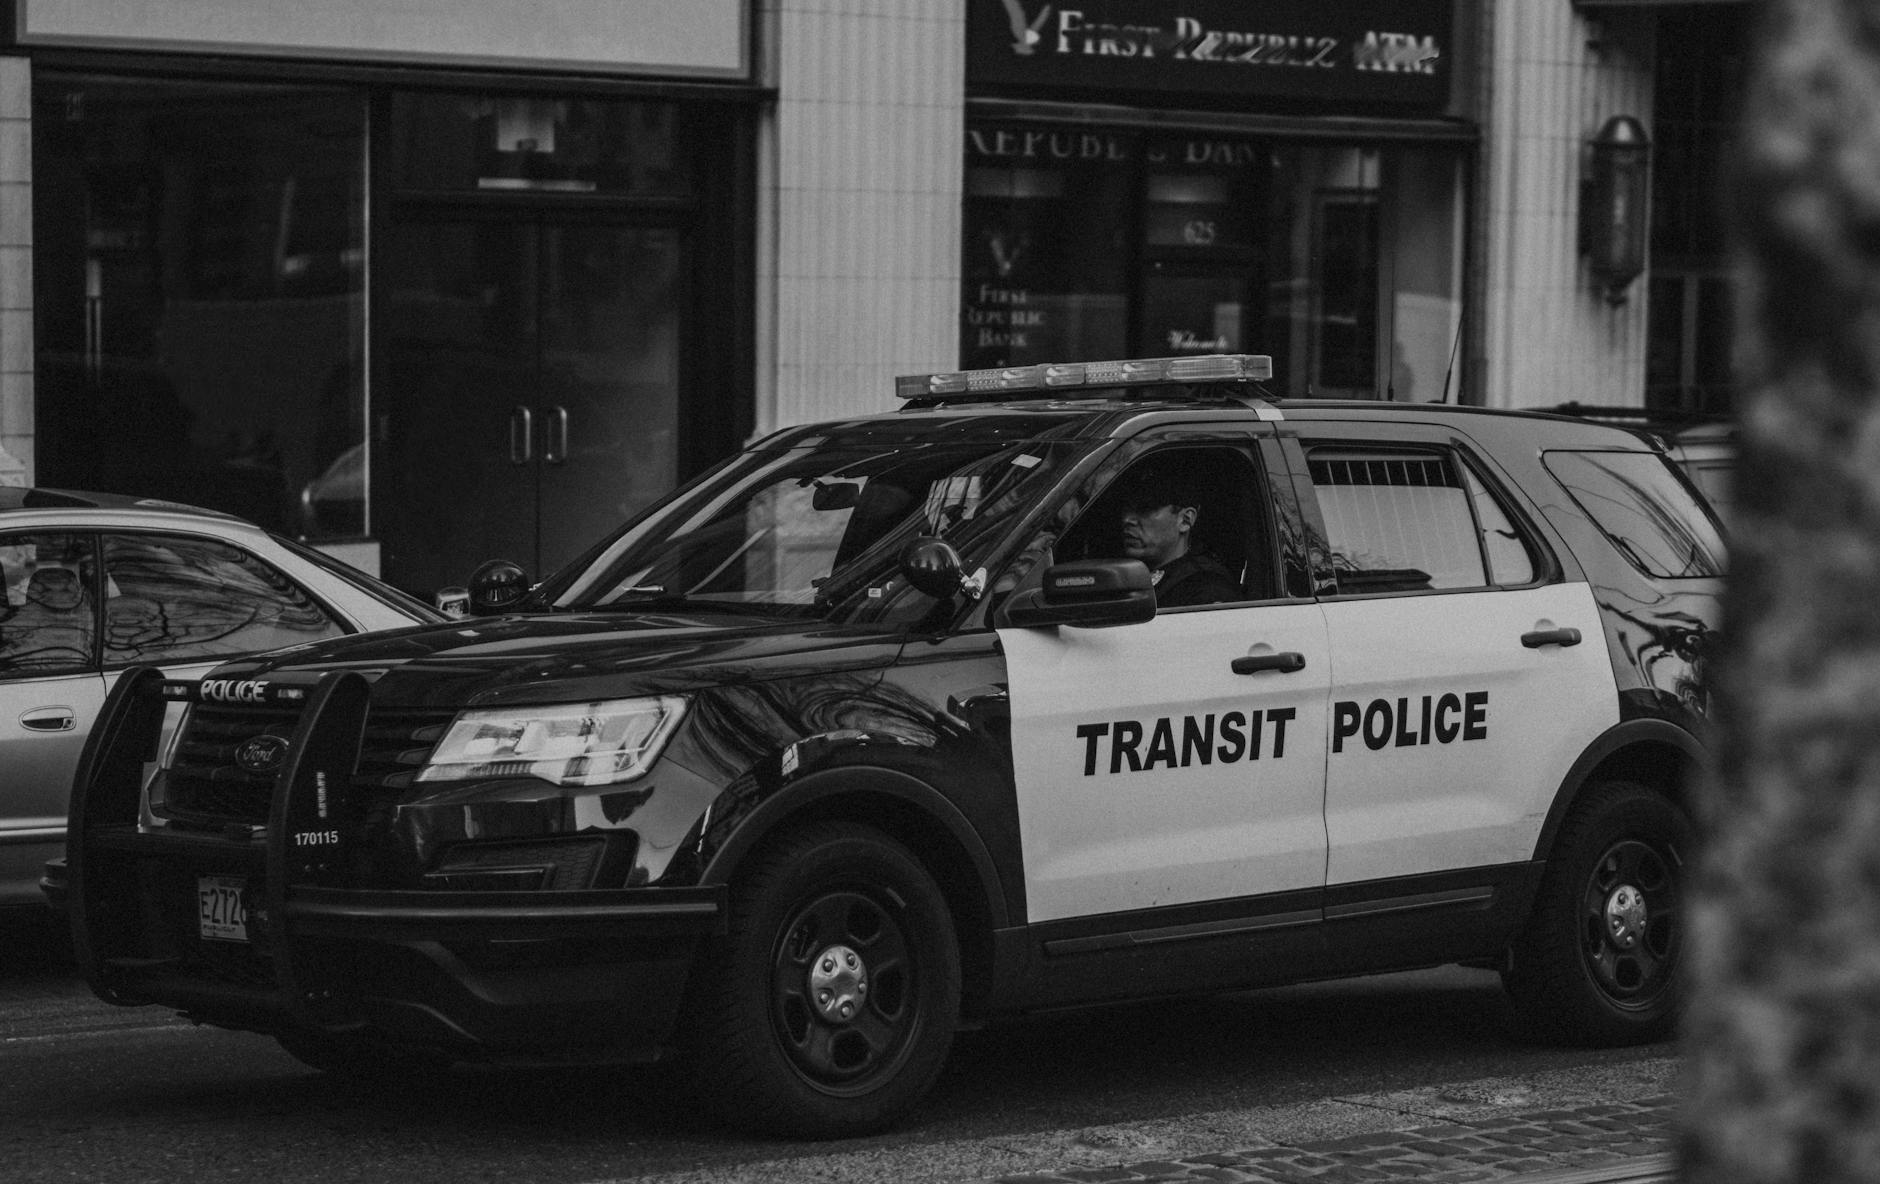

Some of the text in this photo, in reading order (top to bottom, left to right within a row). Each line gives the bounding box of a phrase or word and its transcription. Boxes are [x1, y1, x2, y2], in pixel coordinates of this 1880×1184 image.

[1057, 10, 1160, 57] FIRST
[200, 680, 270, 702] POLICE
[1076, 691, 1488, 776] TRANSIT POLICE
[294, 830, 339, 846] 170115
